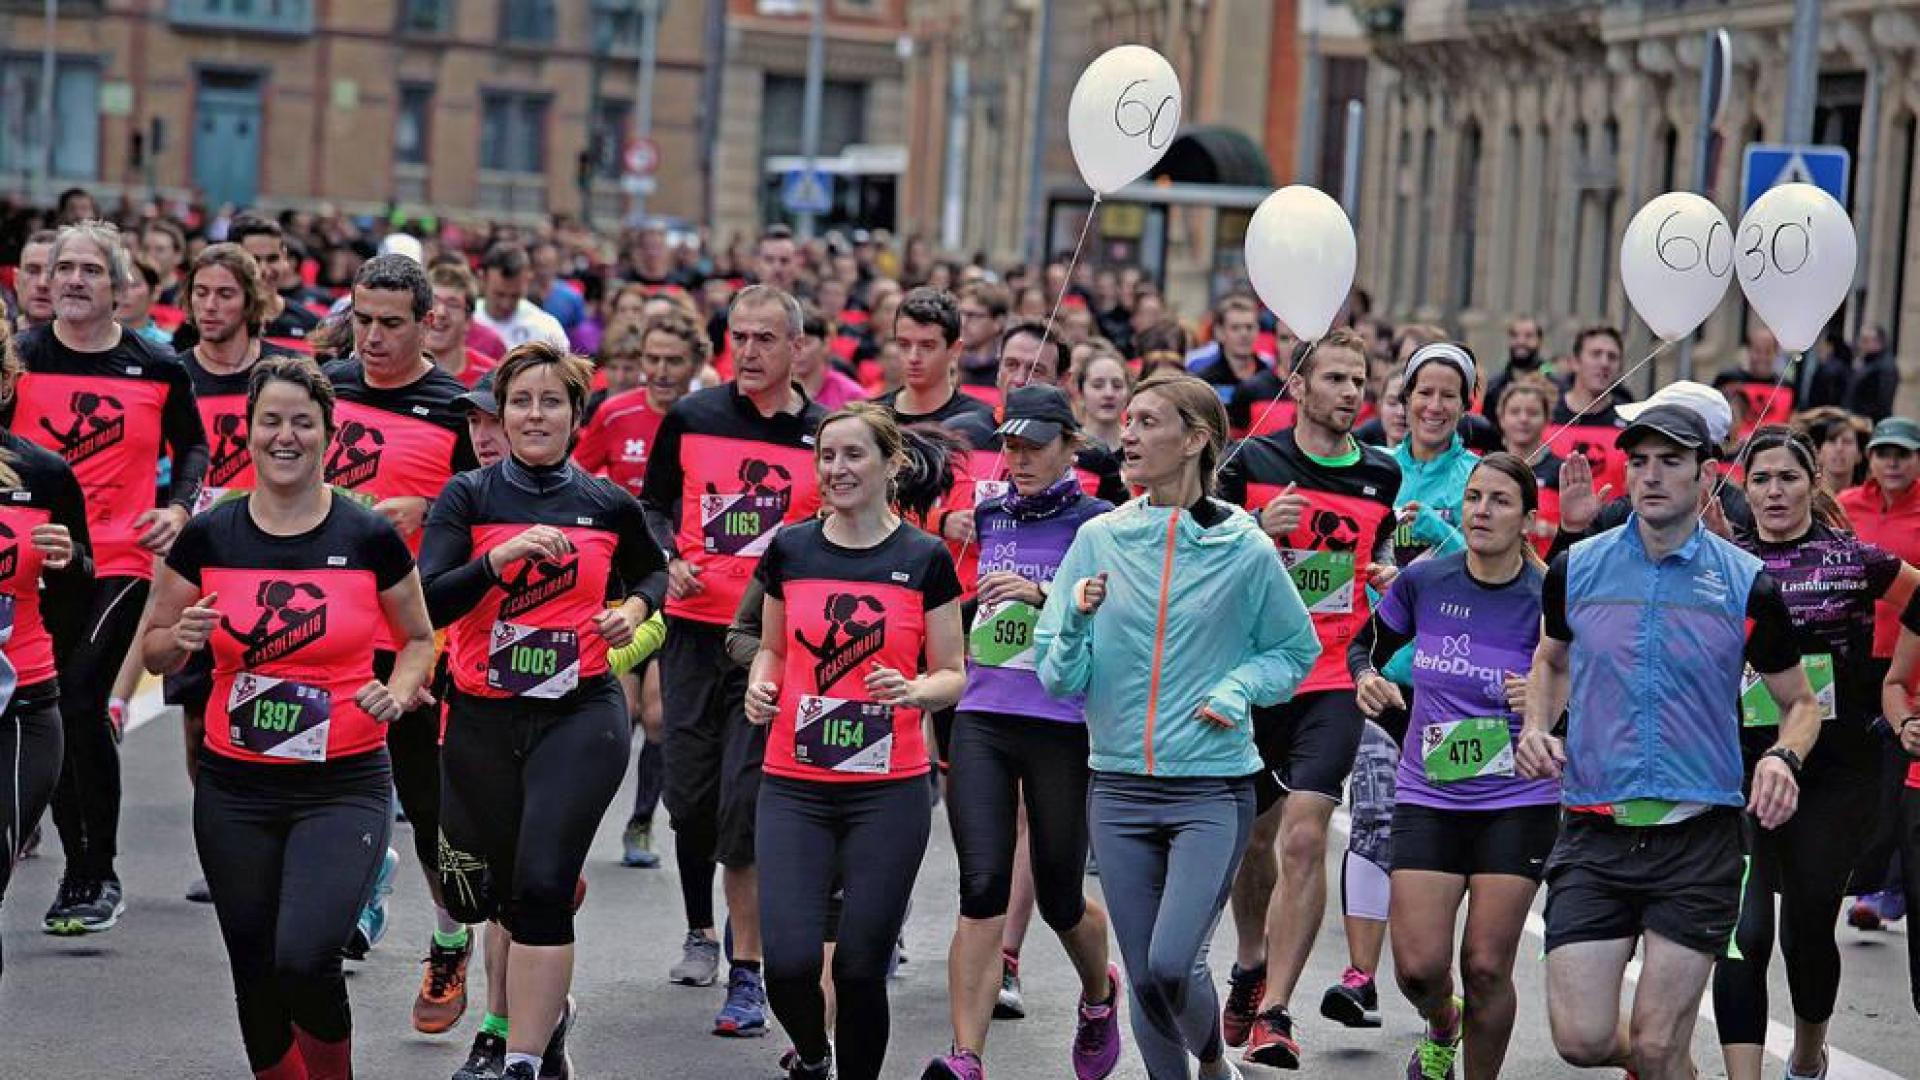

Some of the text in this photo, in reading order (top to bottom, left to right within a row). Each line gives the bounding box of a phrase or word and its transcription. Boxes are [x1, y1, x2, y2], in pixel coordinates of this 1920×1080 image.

[1115, 79, 1178, 150] 60
[1656, 210, 1732, 278] 60
[725, 511, 759, 536] 1163
[1296, 569, 1331, 592] 305
[994, 619, 1027, 646] 593
[511, 645, 558, 676] 1003
[253, 698, 303, 733] 1397
[823, 718, 864, 748] 1154
[1450, 738, 1483, 765] 473
